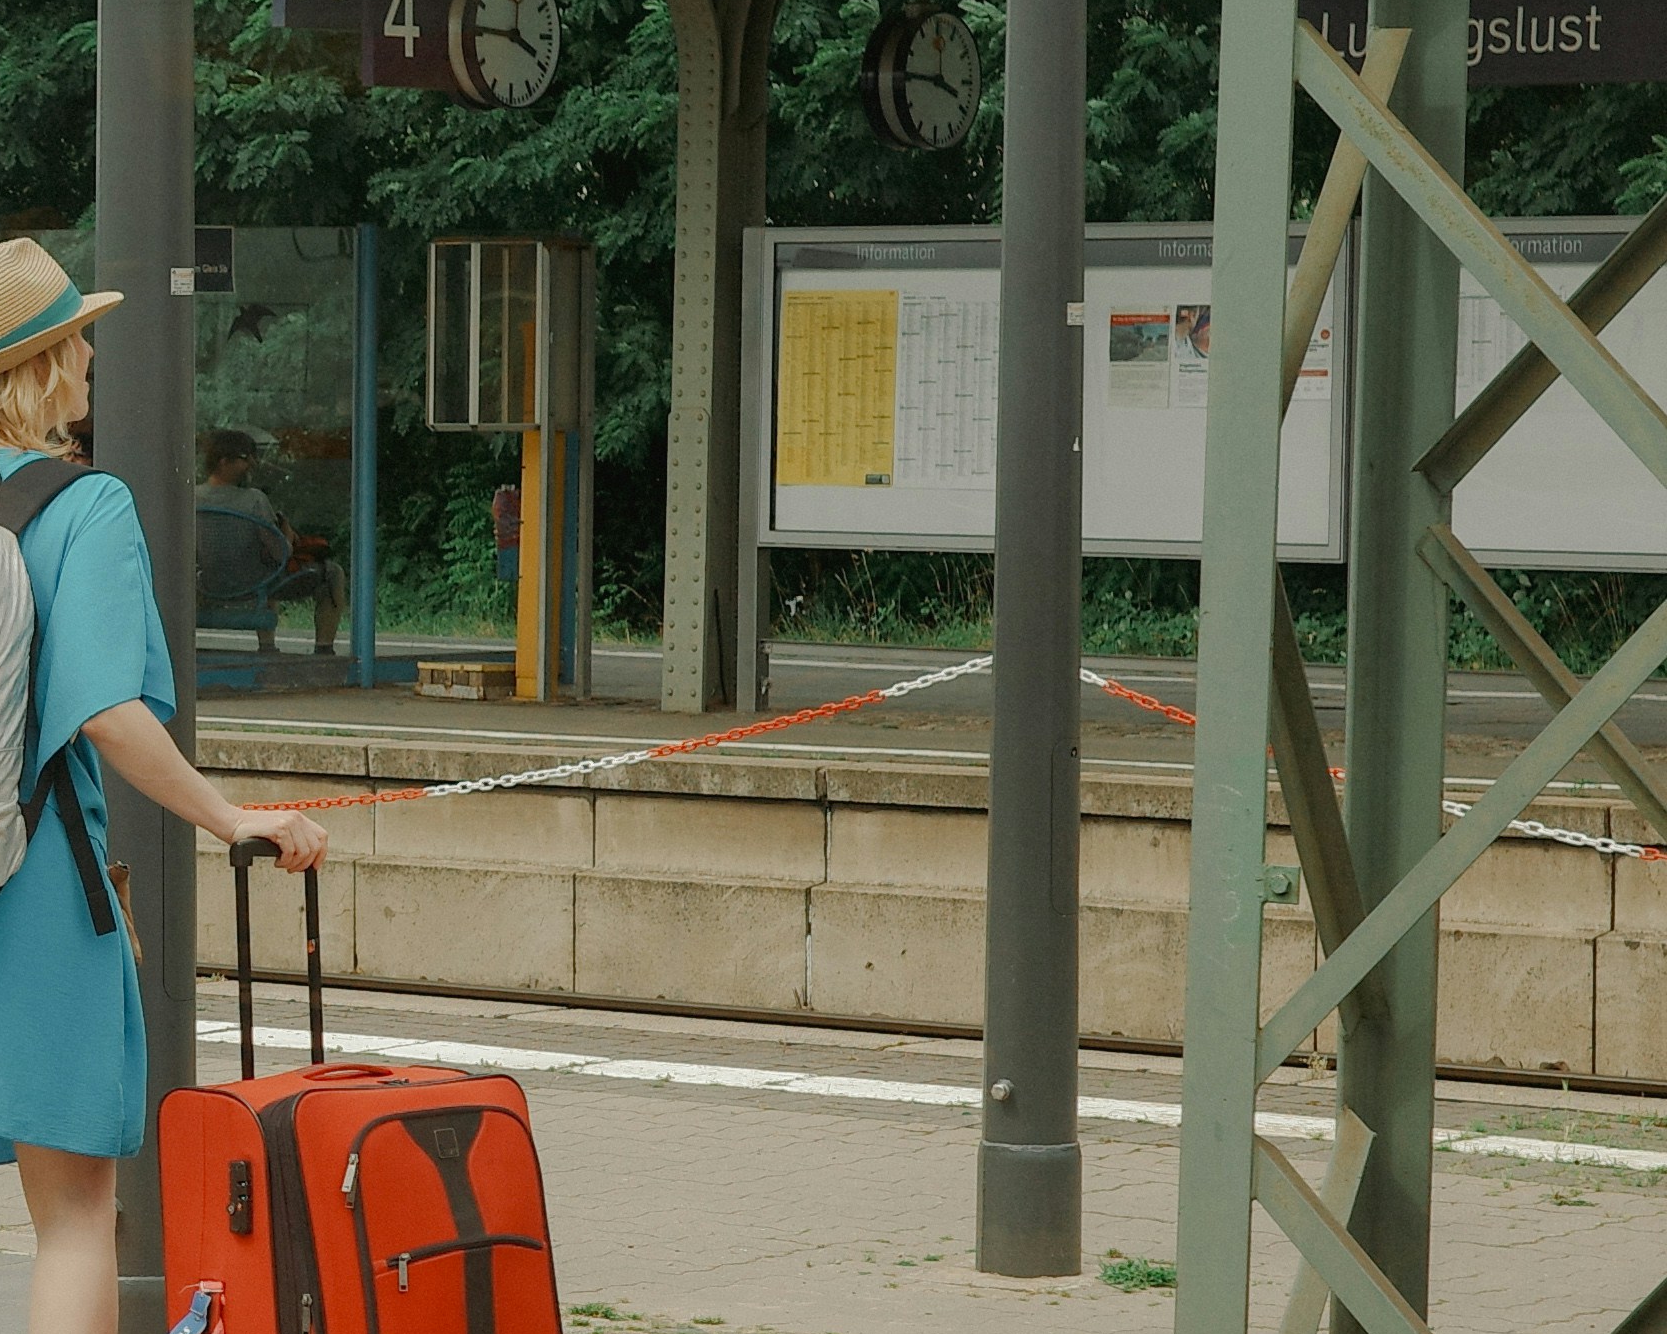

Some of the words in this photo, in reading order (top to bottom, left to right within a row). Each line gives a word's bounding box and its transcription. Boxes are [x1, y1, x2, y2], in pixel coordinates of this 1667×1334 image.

[1321, 5, 1603, 67] Lugslust
[856, 244, 936, 260] Information
[1159, 240, 1212, 257] Informa
[1510, 235, 1582, 255] ormation
